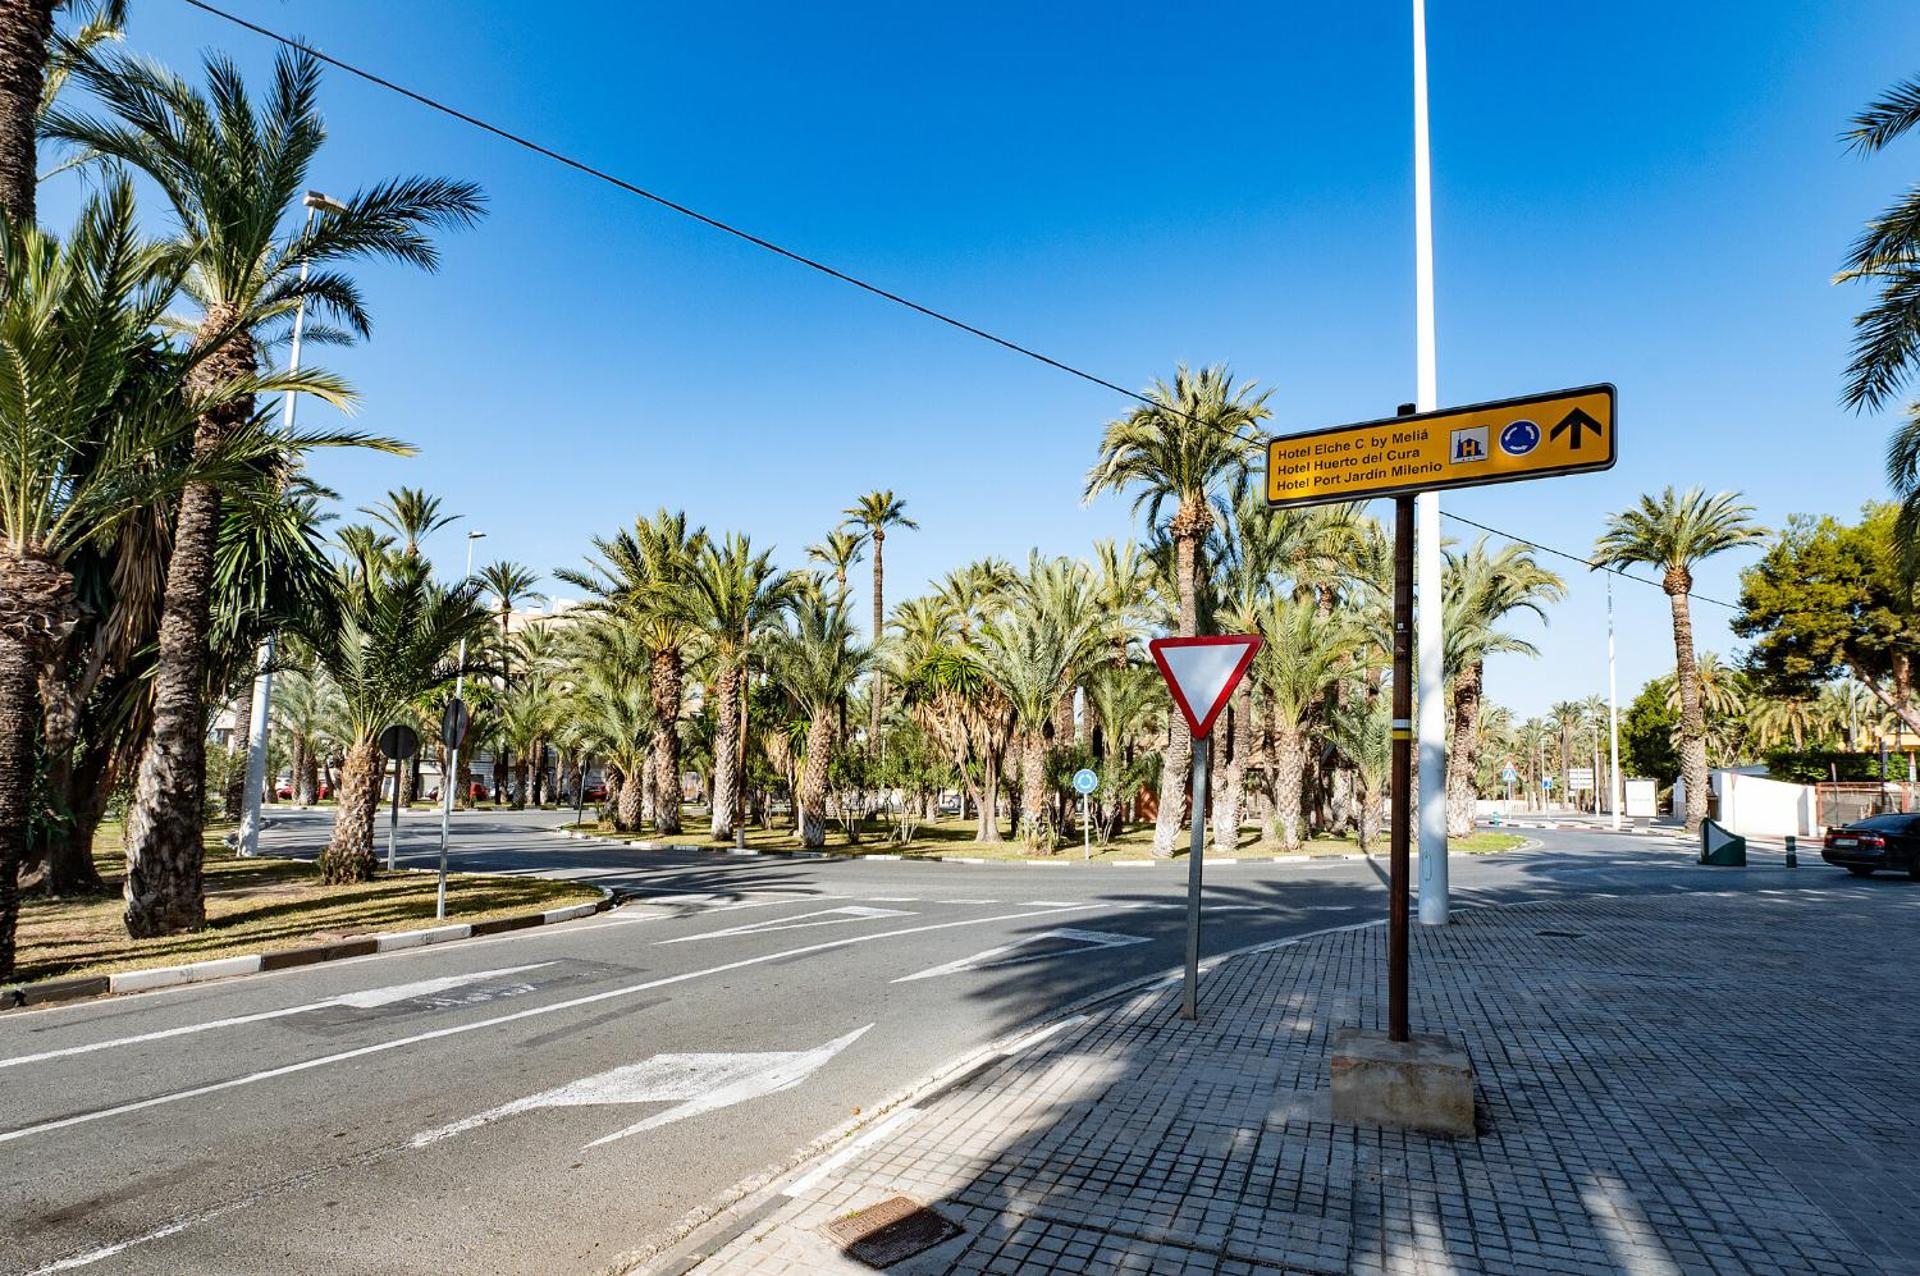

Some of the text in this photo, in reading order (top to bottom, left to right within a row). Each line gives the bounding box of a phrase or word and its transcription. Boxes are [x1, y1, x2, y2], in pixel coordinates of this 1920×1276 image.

[1278, 447, 1310, 460] Hotel
[1315, 442, 1350, 456] Elche
[1370, 436, 1387, 449] by
[1391, 428, 1428, 443] Meliá
[1278, 448, 1420, 475] Hotel Huerto del Cura
[1277, 462, 1442, 491] Hotel Port Jardín Milenio
